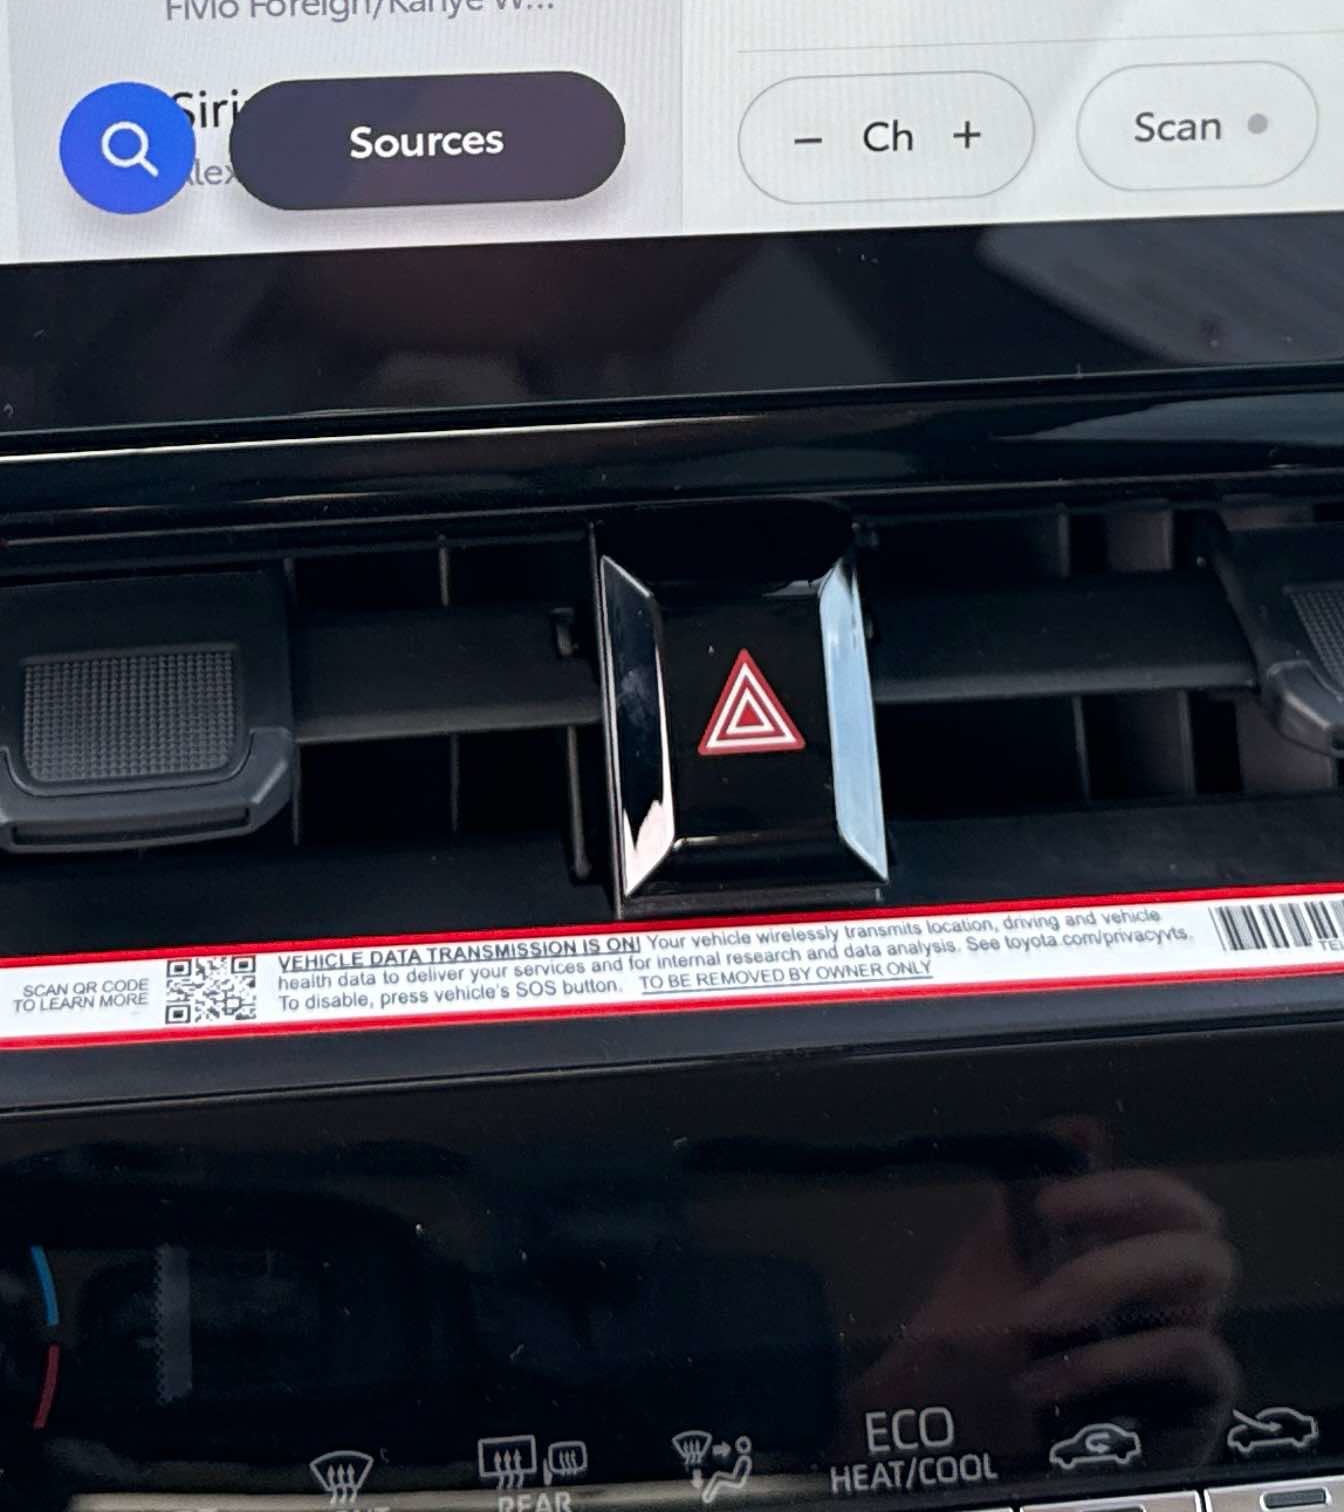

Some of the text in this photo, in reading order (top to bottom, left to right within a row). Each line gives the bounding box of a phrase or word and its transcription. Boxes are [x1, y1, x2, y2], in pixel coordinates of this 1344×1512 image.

[349, 126, 504, 159] Sources
[863, 121, 914, 153] Ch
[1134, 111, 1223, 143] Scan
[278, 952, 363, 970] VEHICLE
[371, 949, 422, 964] DATA
[427, 940, 576, 962] TRANSMISSION
[583, 939, 600, 953] IS
[646, 937, 687, 950] Your
[692, 931, 751, 947] vehicle
[757, 926, 839, 943] wirelessly
[845, 922, 922, 938] transmits
[1004, 915, 1060, 931] driving
[1066, 912, 1096, 927] and
[1101, 908, 1161, 924] vehicle
[279, 974, 332, 990] health
[338, 972, 376, 987] data
[384, 971, 399, 984] to
[407, 968, 465, 983] deliver
[471, 966, 508, 983] your
[514, 962, 585, 976] services
[592, 958, 623, 972] and
[628, 955, 651, 970] for
[657, 952, 721, 969] internal
[727, 948, 801, 964] research
[808, 945, 838, 960] and
[844, 944, 881, 958] data
[966, 937, 1000, 951] See
[13, 992, 149, 1012] TO LEARN MORE
[23, 978, 149, 998] SCAN QR CODE
[279, 996, 299, 1012] To
[381, 990, 428, 1009] press
[516, 981, 556, 997] SOS
[639, 975, 663, 989] TO
[668, 974, 691, 987] BE
[696, 968, 784, 986] REMOVED
[789, 967, 813, 981] BY
[817, 964, 883, 979] OWNER
[887, 960, 932, 975] ONLY
[865, 1406, 955, 1453] ECO
[830, 1452, 999, 1494] HEAT/COOL
